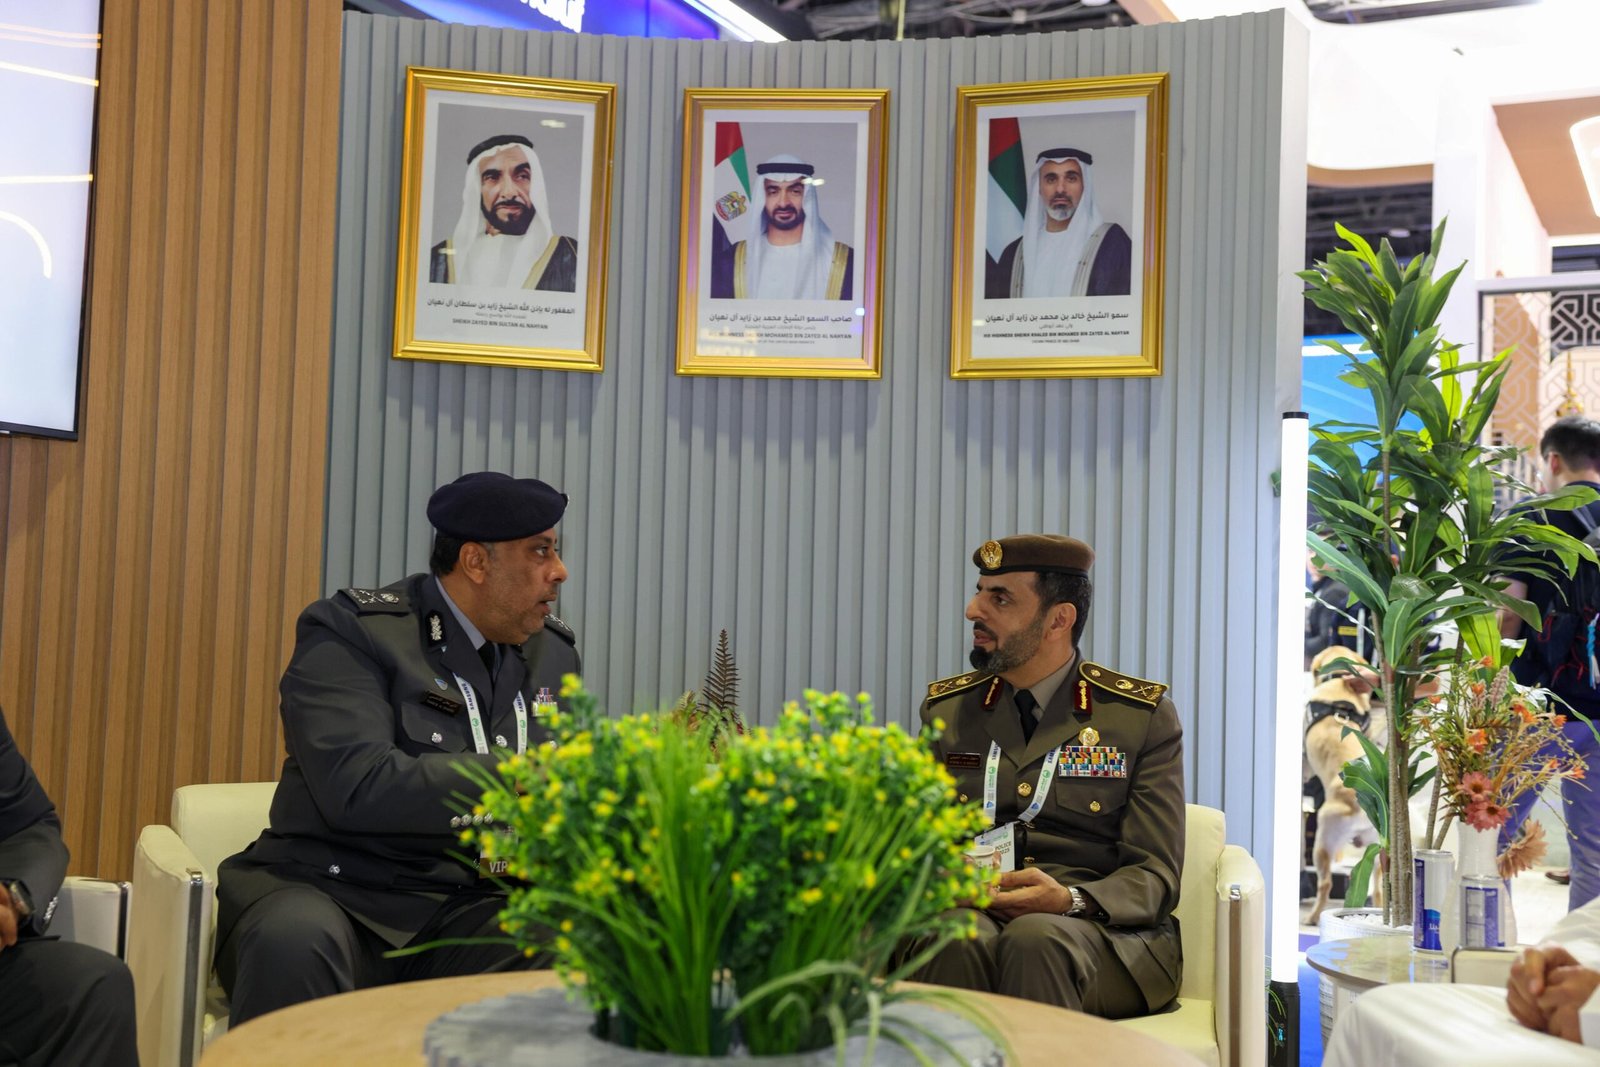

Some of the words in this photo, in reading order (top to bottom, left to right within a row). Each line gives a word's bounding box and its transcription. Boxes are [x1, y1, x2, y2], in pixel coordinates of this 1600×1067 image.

[753, 314, 761, 322] بن
[783, 314, 805, 324] الشيخ
[1029, 313, 1038, 321] بن
[1060, 313, 1069, 321] بن
[1086, 311, 1109, 322] الشيخ
[489, 861, 508, 873] VIP
